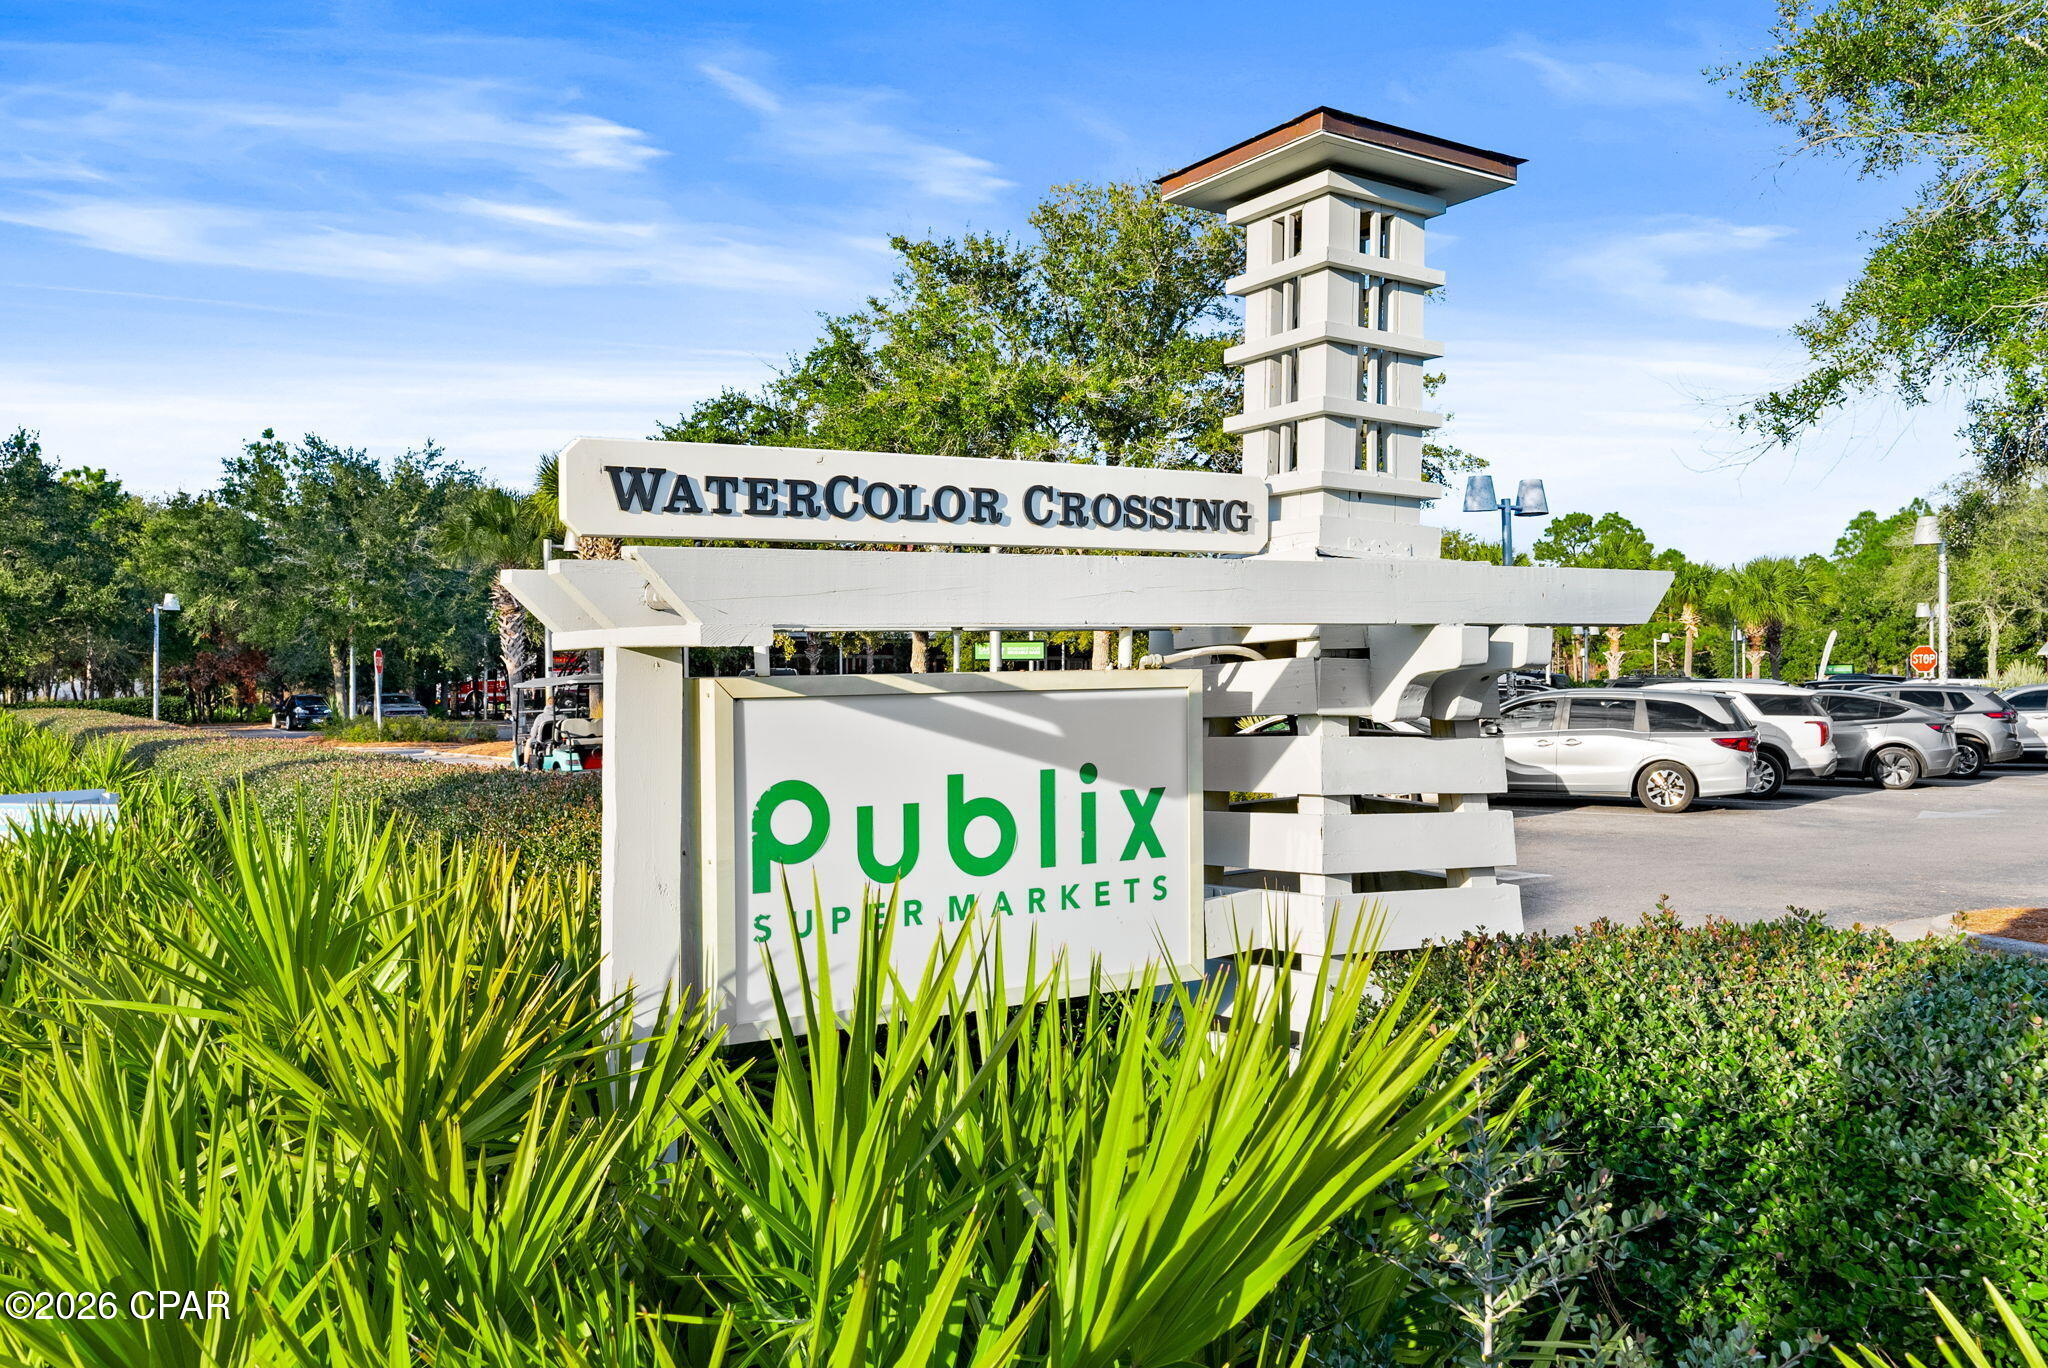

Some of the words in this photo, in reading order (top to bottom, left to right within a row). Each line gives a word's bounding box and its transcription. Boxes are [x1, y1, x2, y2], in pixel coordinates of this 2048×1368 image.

[1912, 654, 1935, 664] STOP
[751, 761, 1167, 895] Publix
[948, 874, 1169, 923] MARKETS
